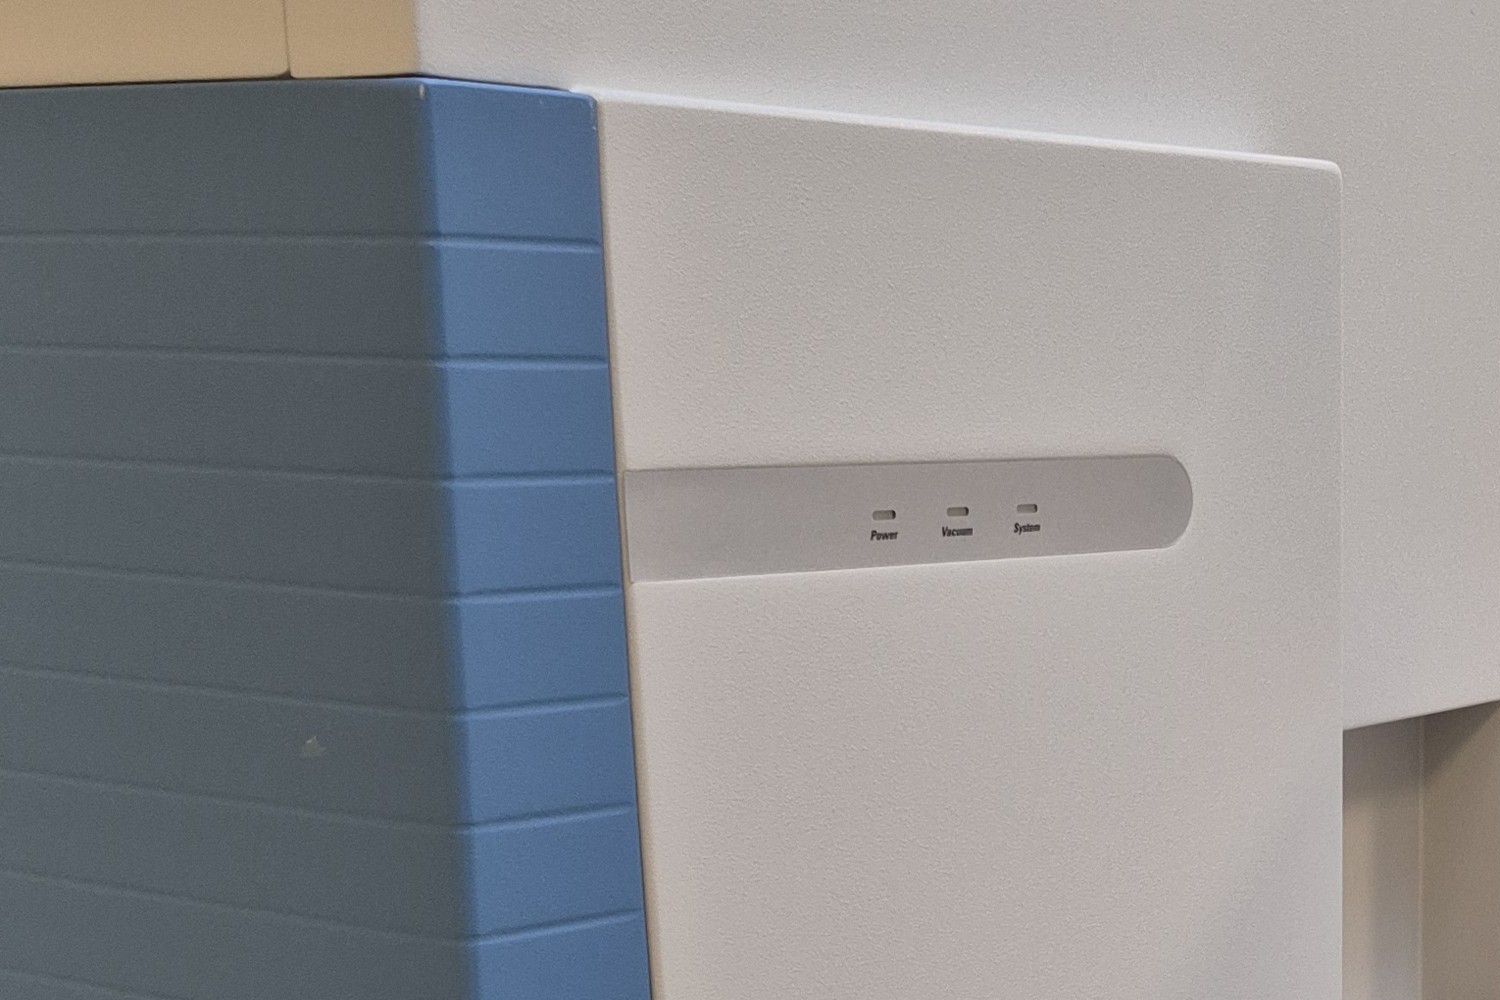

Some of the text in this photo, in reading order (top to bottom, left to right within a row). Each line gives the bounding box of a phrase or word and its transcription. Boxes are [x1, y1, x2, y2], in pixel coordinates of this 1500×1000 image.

[941, 526, 973, 537] Vacuum
[1013, 522, 1041, 535] System
[870, 530, 898, 541] Power
